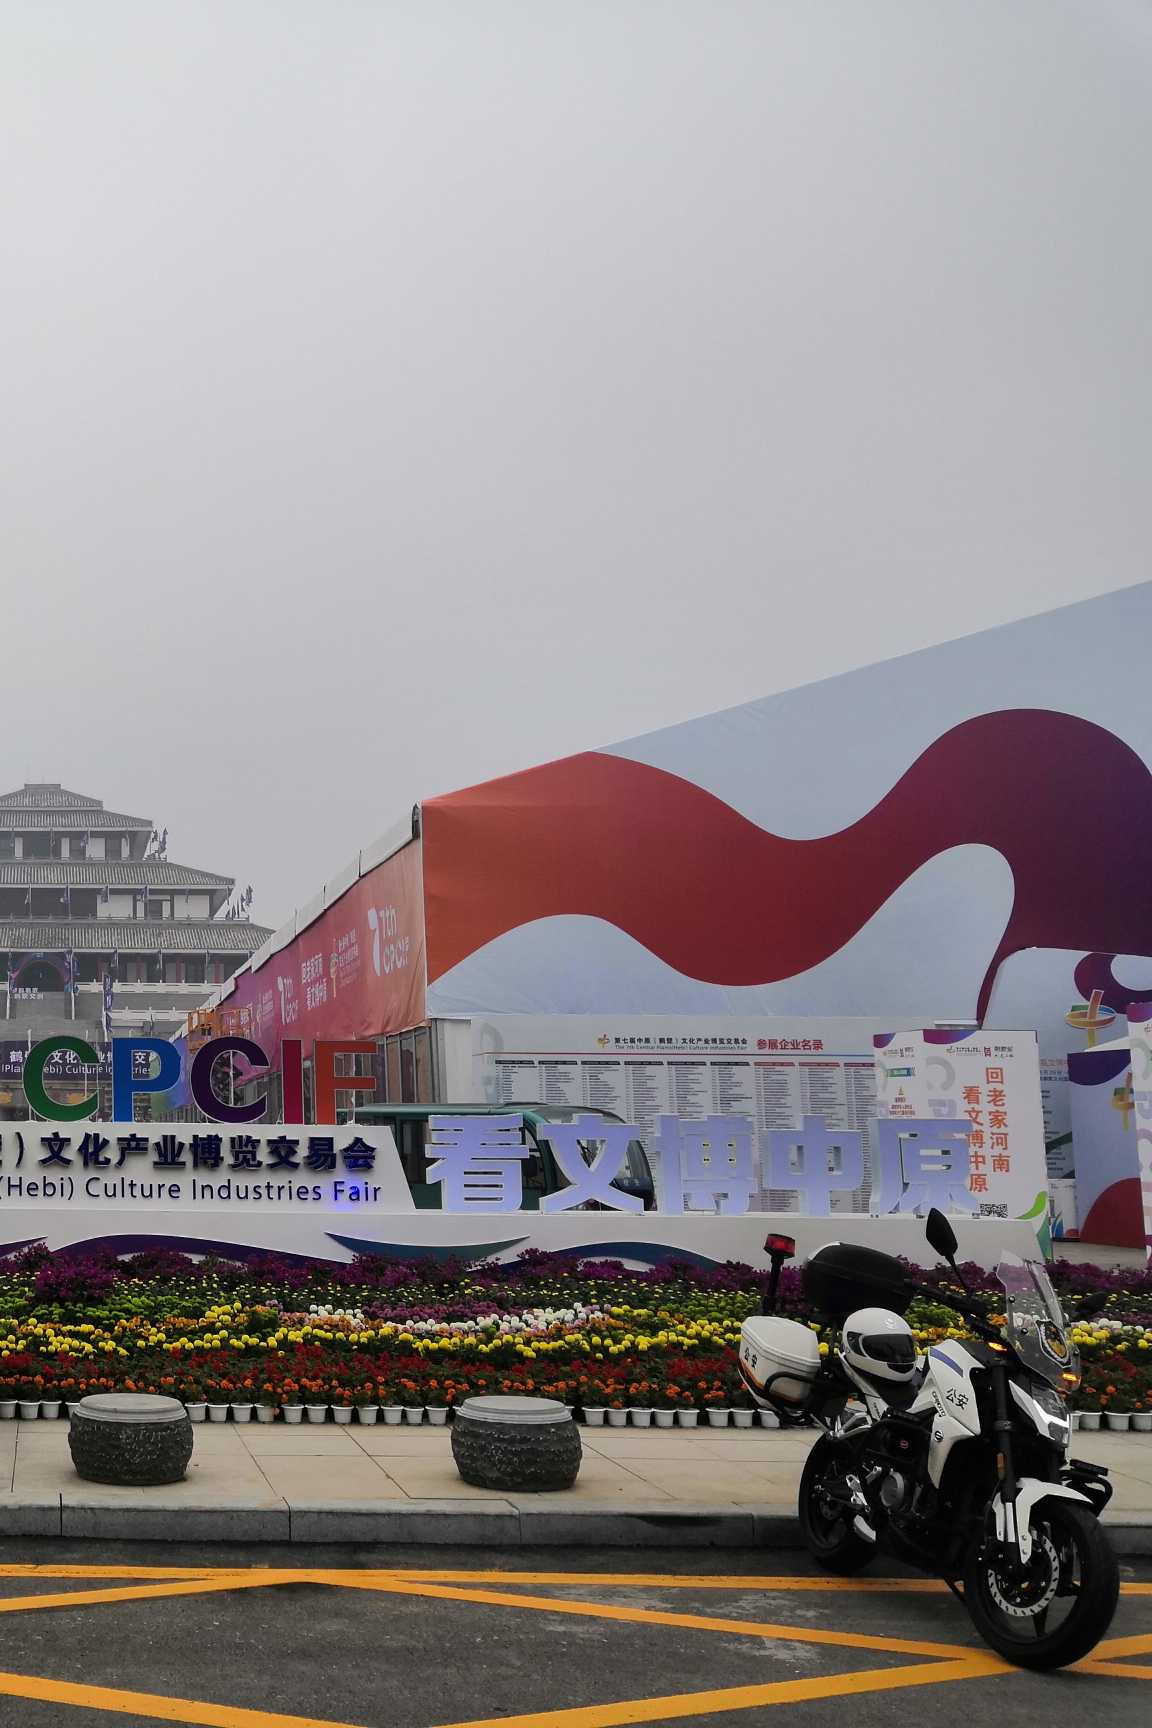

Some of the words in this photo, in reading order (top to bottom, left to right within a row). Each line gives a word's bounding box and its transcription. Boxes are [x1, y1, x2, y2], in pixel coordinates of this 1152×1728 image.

[23, 1035, 377, 1124] CPCIF
[757, 1039, 823, 1051] 参展企业名录
[962, 1085, 989, 1192] 看文博中原
[986, 1067, 1010, 1173] 回老家河南
[85, 1176, 181, 1199] Culture
[192, 1178, 322, 1201] Industries
[333, 1180, 382, 1202] Fair
[425, 1113, 981, 1217] 看文博中原
[946, 1388, 969, 1410] 公安
